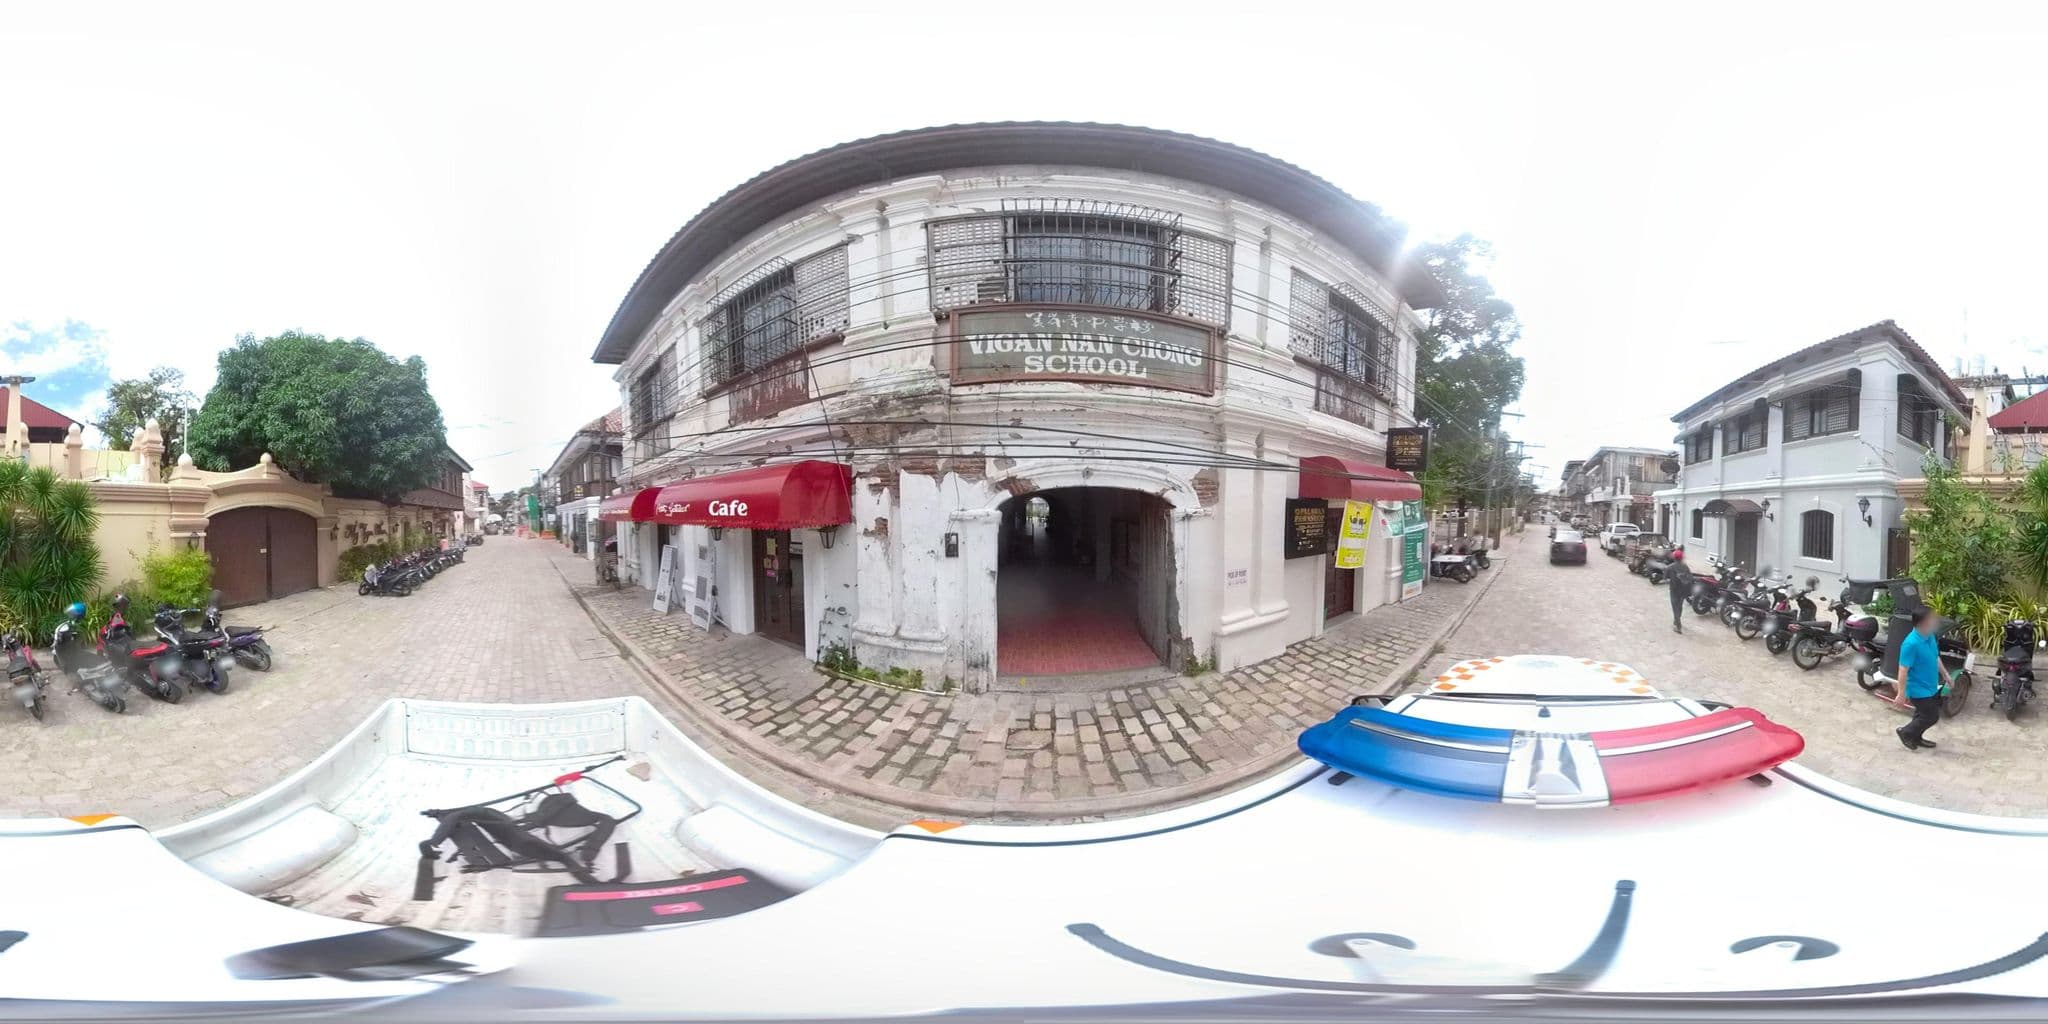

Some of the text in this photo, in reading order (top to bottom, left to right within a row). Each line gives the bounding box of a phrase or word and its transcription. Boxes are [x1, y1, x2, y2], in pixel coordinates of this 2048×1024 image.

[966, 332, 1203, 367] VIGAN NAN CHONG
[1024, 354, 1147, 378] SCHOOL
[708, 499, 749, 517] Cafe
